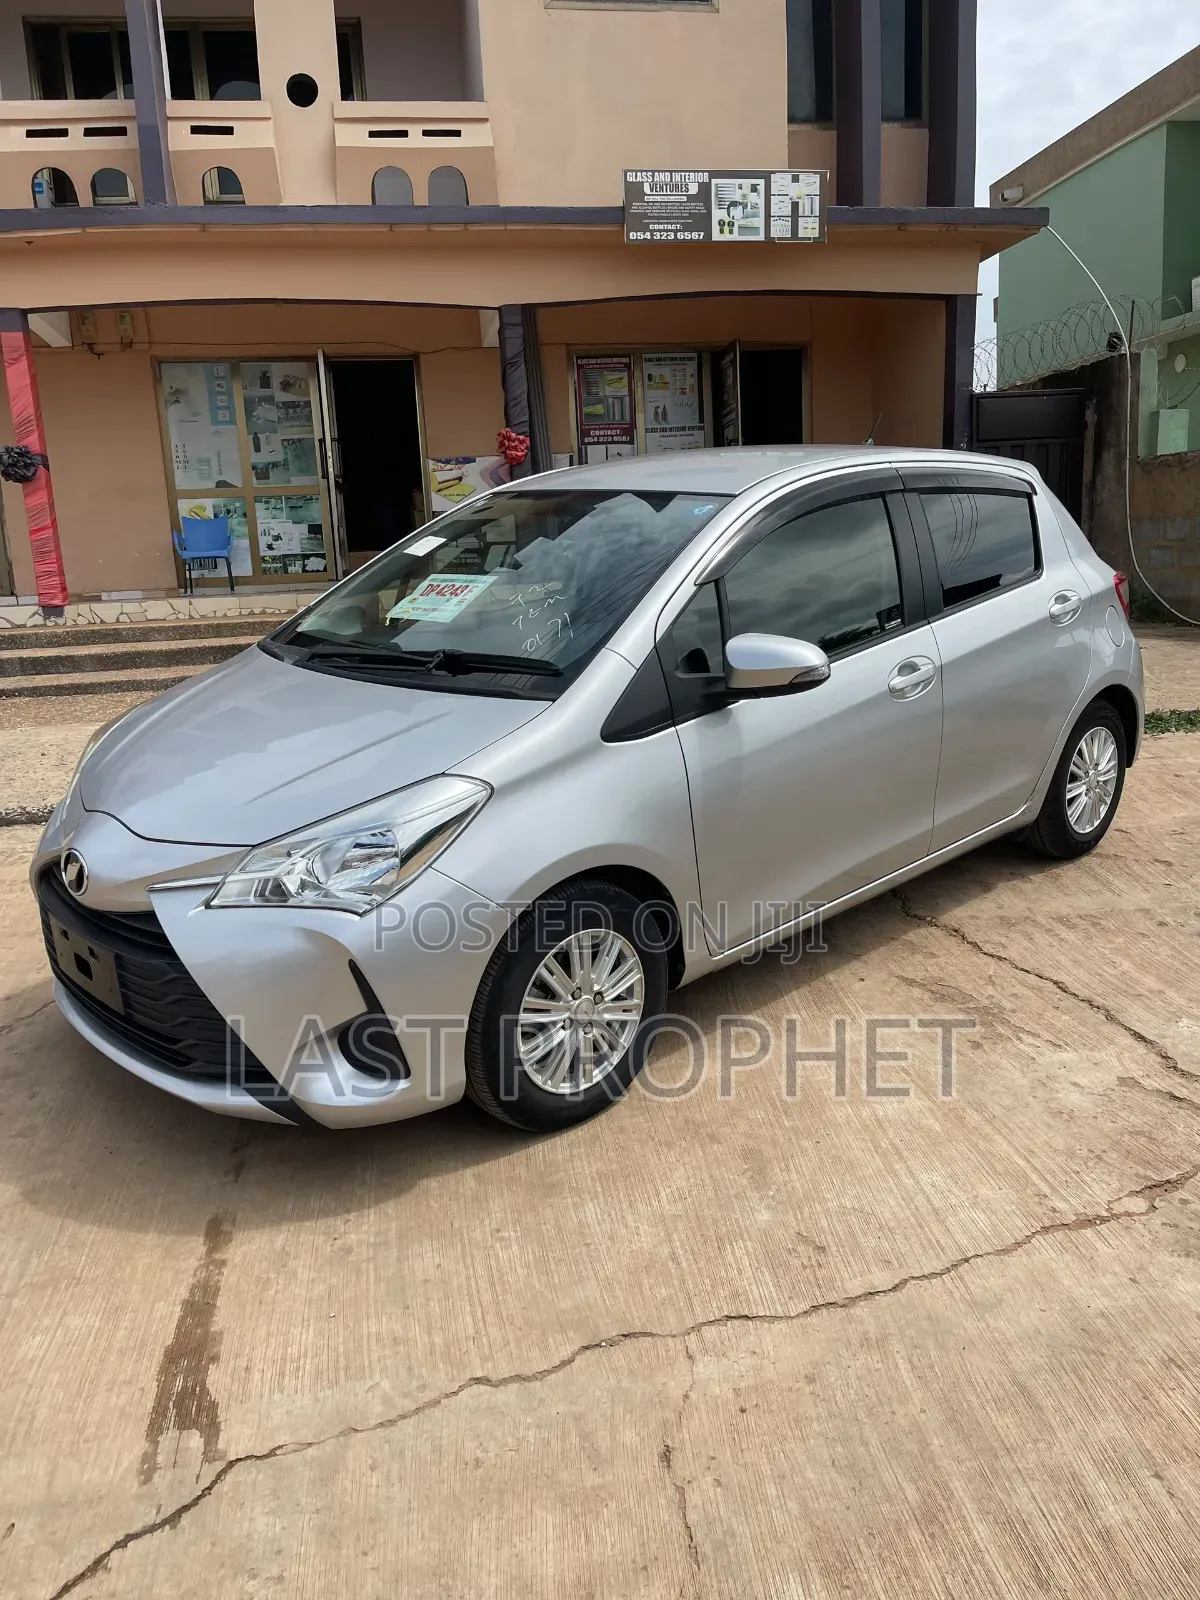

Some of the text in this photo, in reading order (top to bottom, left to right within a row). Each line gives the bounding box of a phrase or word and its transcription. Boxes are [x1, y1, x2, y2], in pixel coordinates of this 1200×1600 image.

[627, 172, 709, 183] GLASS AND INTERIOR
[649, 183, 689, 193] VENTURES
[629, 231, 705, 240] 054 323 6567
